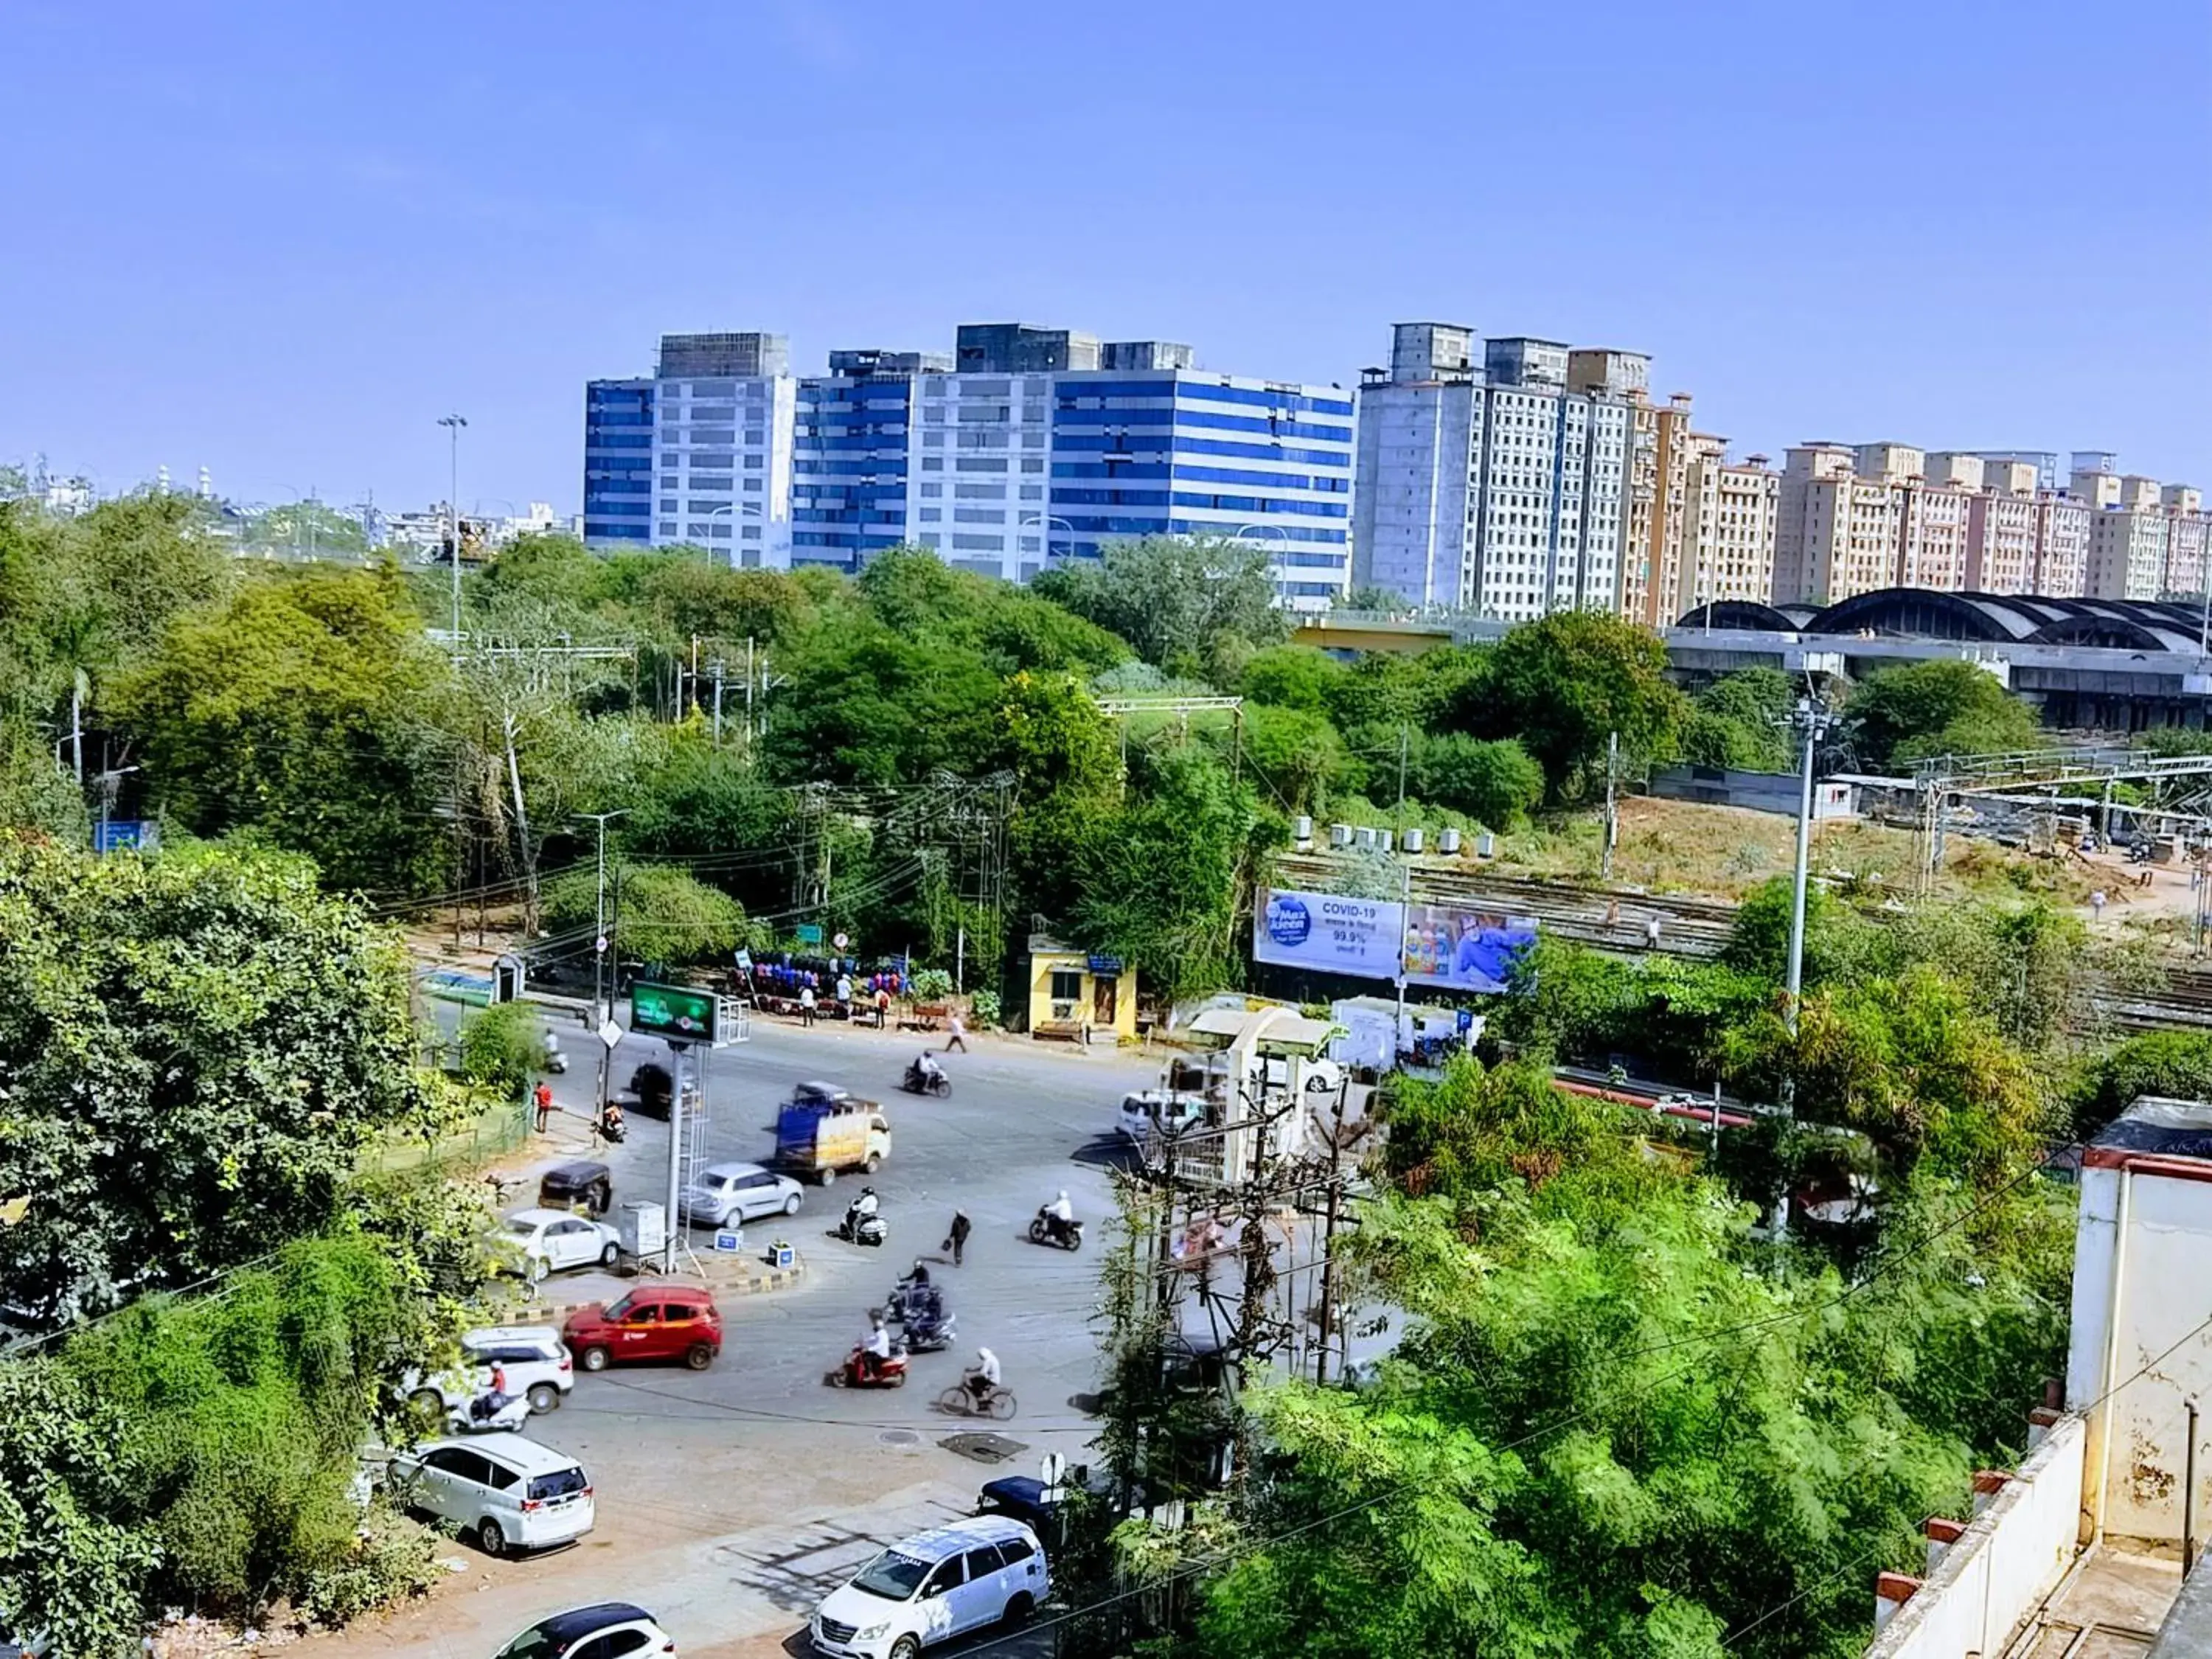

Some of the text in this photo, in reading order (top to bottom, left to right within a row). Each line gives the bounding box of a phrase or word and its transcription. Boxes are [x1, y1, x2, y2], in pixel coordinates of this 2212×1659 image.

[1322, 902, 1377, 919] COVID-19
[1333, 930, 1366, 944] 99.9%
[1460, 1014, 1470, 1026] P
